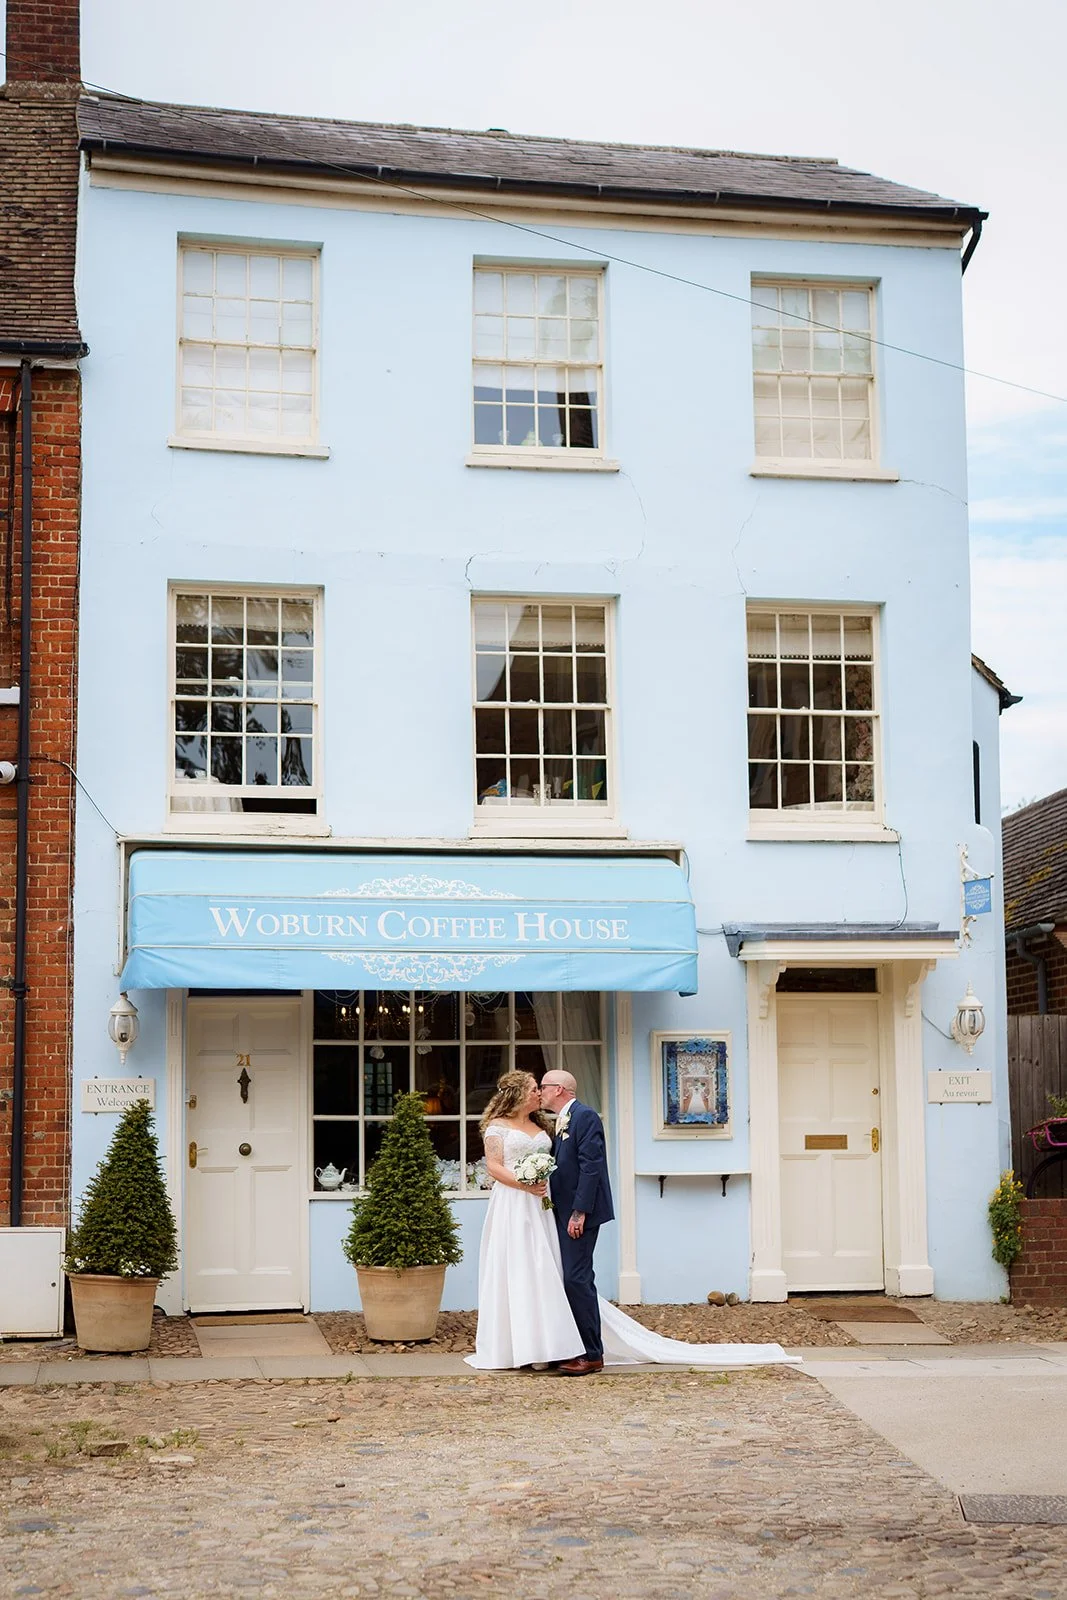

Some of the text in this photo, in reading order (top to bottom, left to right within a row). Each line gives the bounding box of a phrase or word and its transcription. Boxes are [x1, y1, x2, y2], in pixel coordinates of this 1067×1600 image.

[209, 907, 630, 942] WOBURN COFFEE HOUSE
[236, 1054, 251, 1066] 21
[948, 1076, 971, 1085] EXIT
[87, 1084, 150, 1094] ENTRANCE
[943, 1089, 954, 1097] Au
